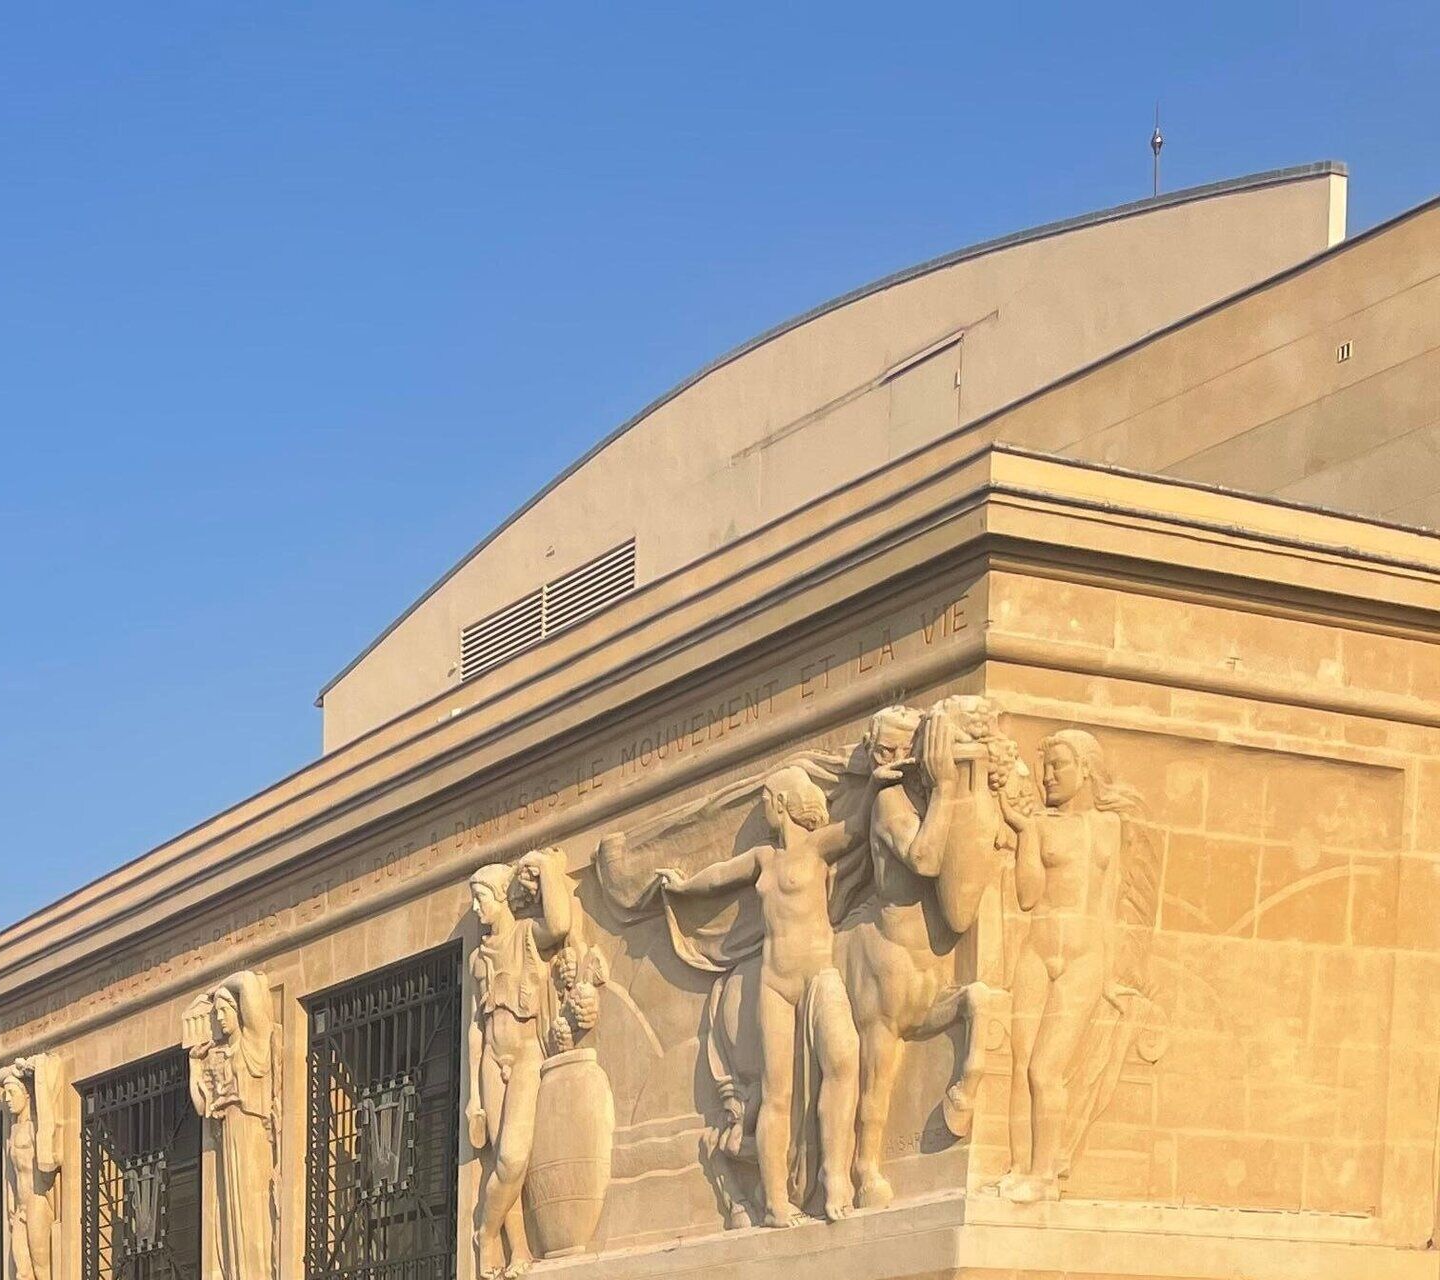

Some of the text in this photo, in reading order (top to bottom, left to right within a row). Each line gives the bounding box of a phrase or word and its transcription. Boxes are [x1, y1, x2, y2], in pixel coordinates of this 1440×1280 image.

[373, 841, 415, 884] DOIT
[576, 757, 604, 797] LE
[620, 678, 779, 778] MOUVEMENT
[799, 653, 836, 700] ET
[857, 625, 897, 674] LA
[920, 594, 969, 647] VIE
